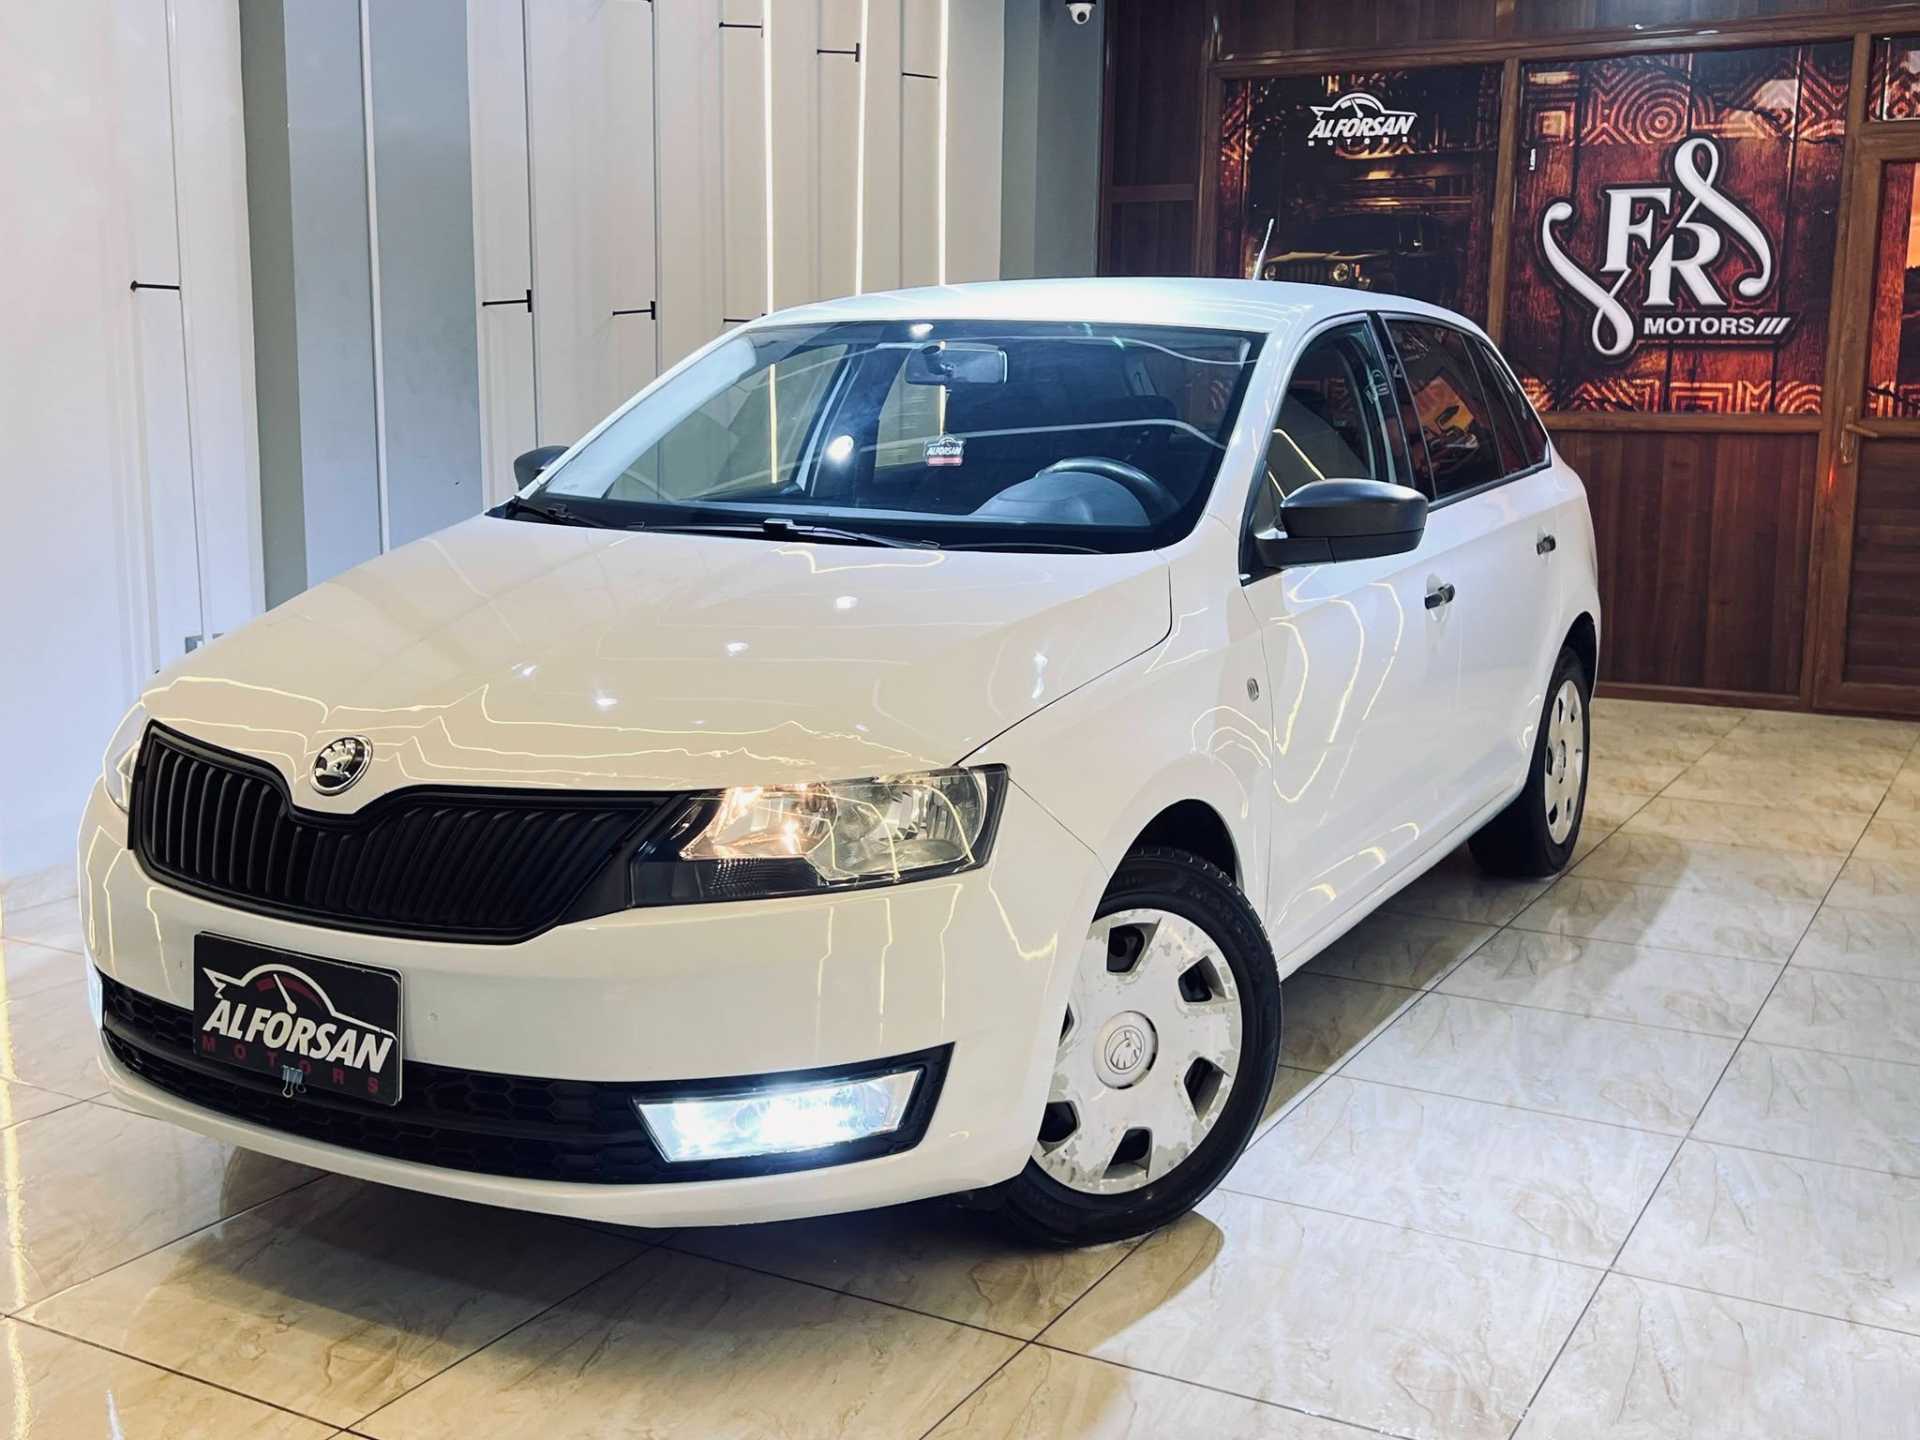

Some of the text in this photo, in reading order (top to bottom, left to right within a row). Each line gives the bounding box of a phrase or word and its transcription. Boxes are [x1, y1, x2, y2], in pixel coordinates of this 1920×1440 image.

[1308, 116, 1415, 138] ALFORSAN
[202, 999, 394, 1074] ALFORSAN
[202, 1034, 380, 1094] MOTORS
